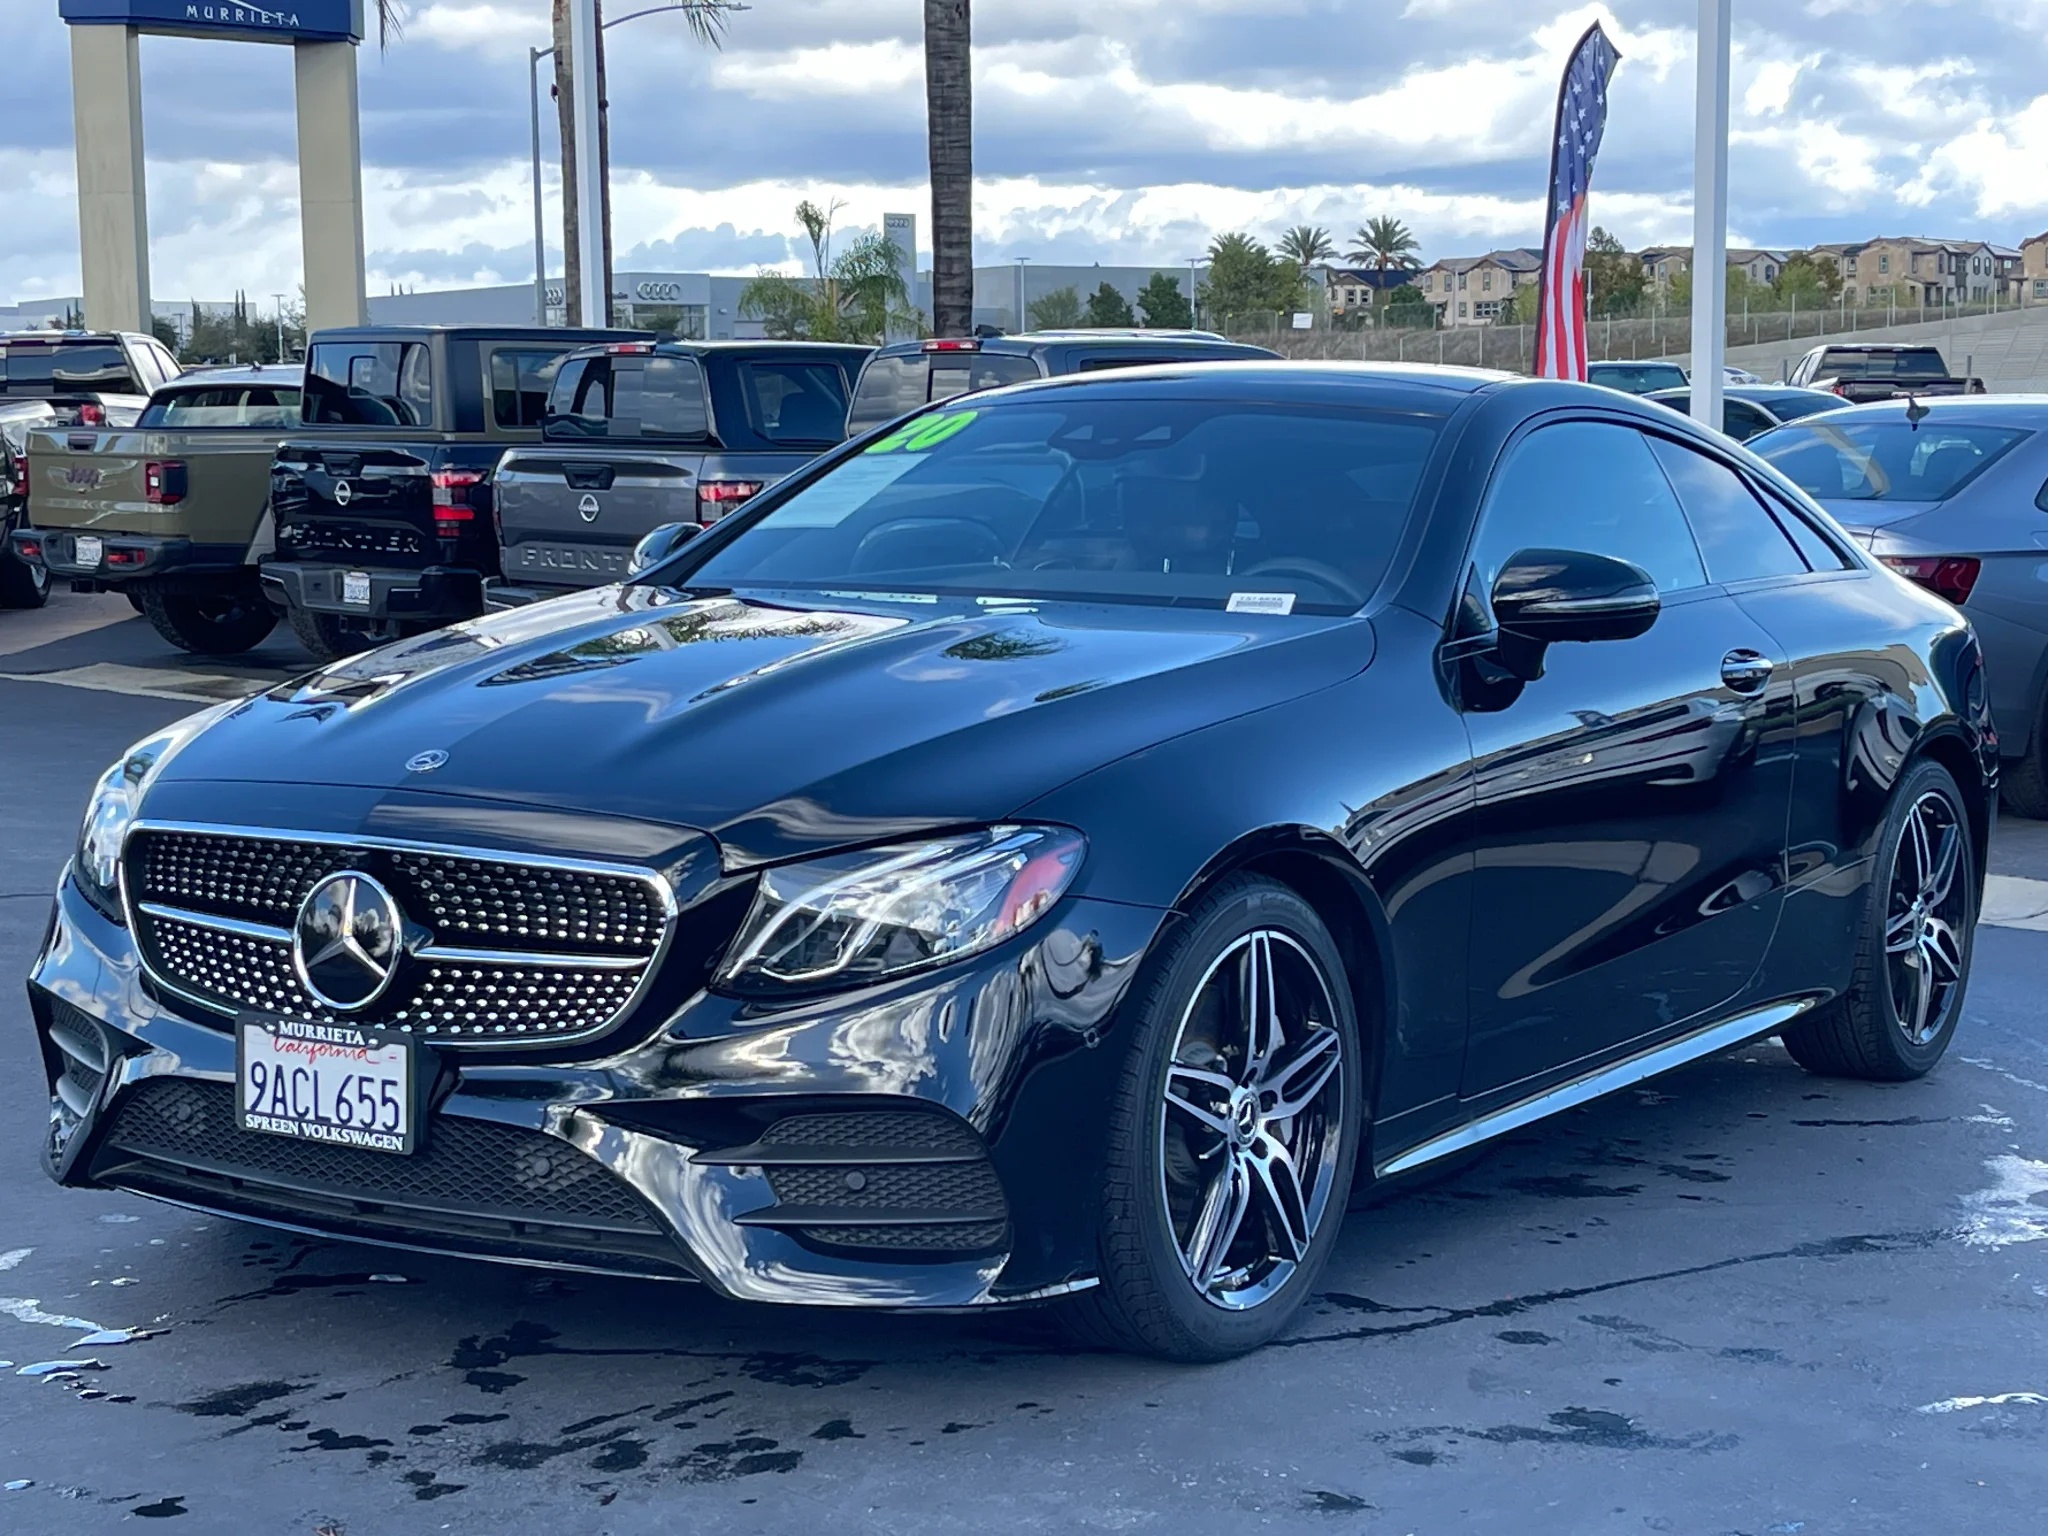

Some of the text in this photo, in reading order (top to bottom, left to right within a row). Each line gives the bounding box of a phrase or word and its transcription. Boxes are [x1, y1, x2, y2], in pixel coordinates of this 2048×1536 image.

[186, 4, 300, 27] MURRIETA
[278, 1021, 365, 1045] MURRIETA
[272, 1036, 381, 1065] California
[250, 1061, 400, 1131] 9ACL655
[245, 1114, 404, 1151] SPREEN VOLKSWAGEN
